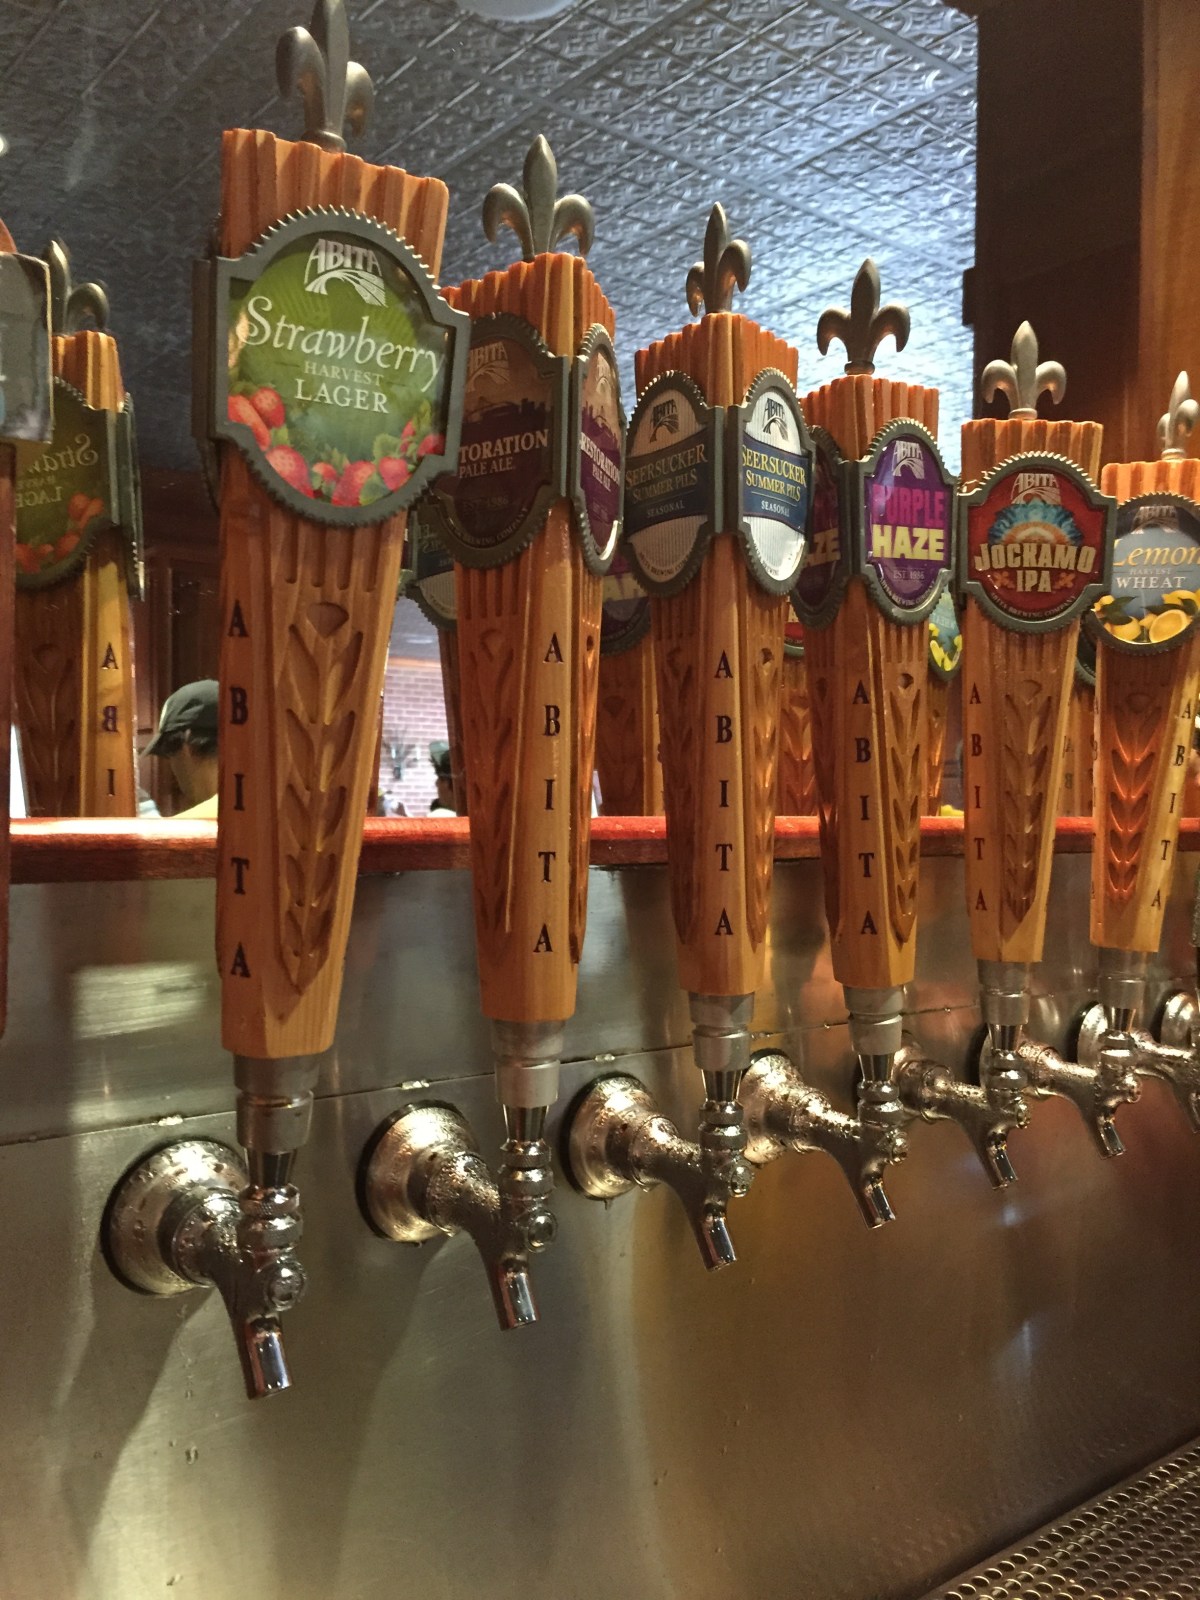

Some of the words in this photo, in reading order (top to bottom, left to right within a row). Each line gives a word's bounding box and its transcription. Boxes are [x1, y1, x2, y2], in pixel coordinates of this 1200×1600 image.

[304, 238, 384, 284] ABITA
[240, 296, 443, 392] Strawberry
[304, 361, 384, 386] HARVEST
[295, 378, 390, 414] LAGER
[458, 428, 549, 464] TORATION
[892, 440, 924, 464] ABITA
[459, 462, 488, 478] PALE
[489, 457, 514, 475] ALE
[626, 444, 708, 490] SEERSUCKER
[742, 444, 808, 488] SEERSUCKER
[633, 474, 673, 503] SUMMER
[675, 469, 698, 490] PILS
[746, 469, 786, 495] SUMMER
[787, 481, 801, 502] PILS
[1011, 473, 1059, 500] ABITA
[761, 500, 791, 518] SEASONAL
[872, 484, 944, 527] PURPLE
[872, 524, 944, 561] HAZE
[973, 542, 1096, 574] JOCKAMO
[1016, 570, 1052, 592] IPA
[1116, 576, 1186, 589] WHEAT
